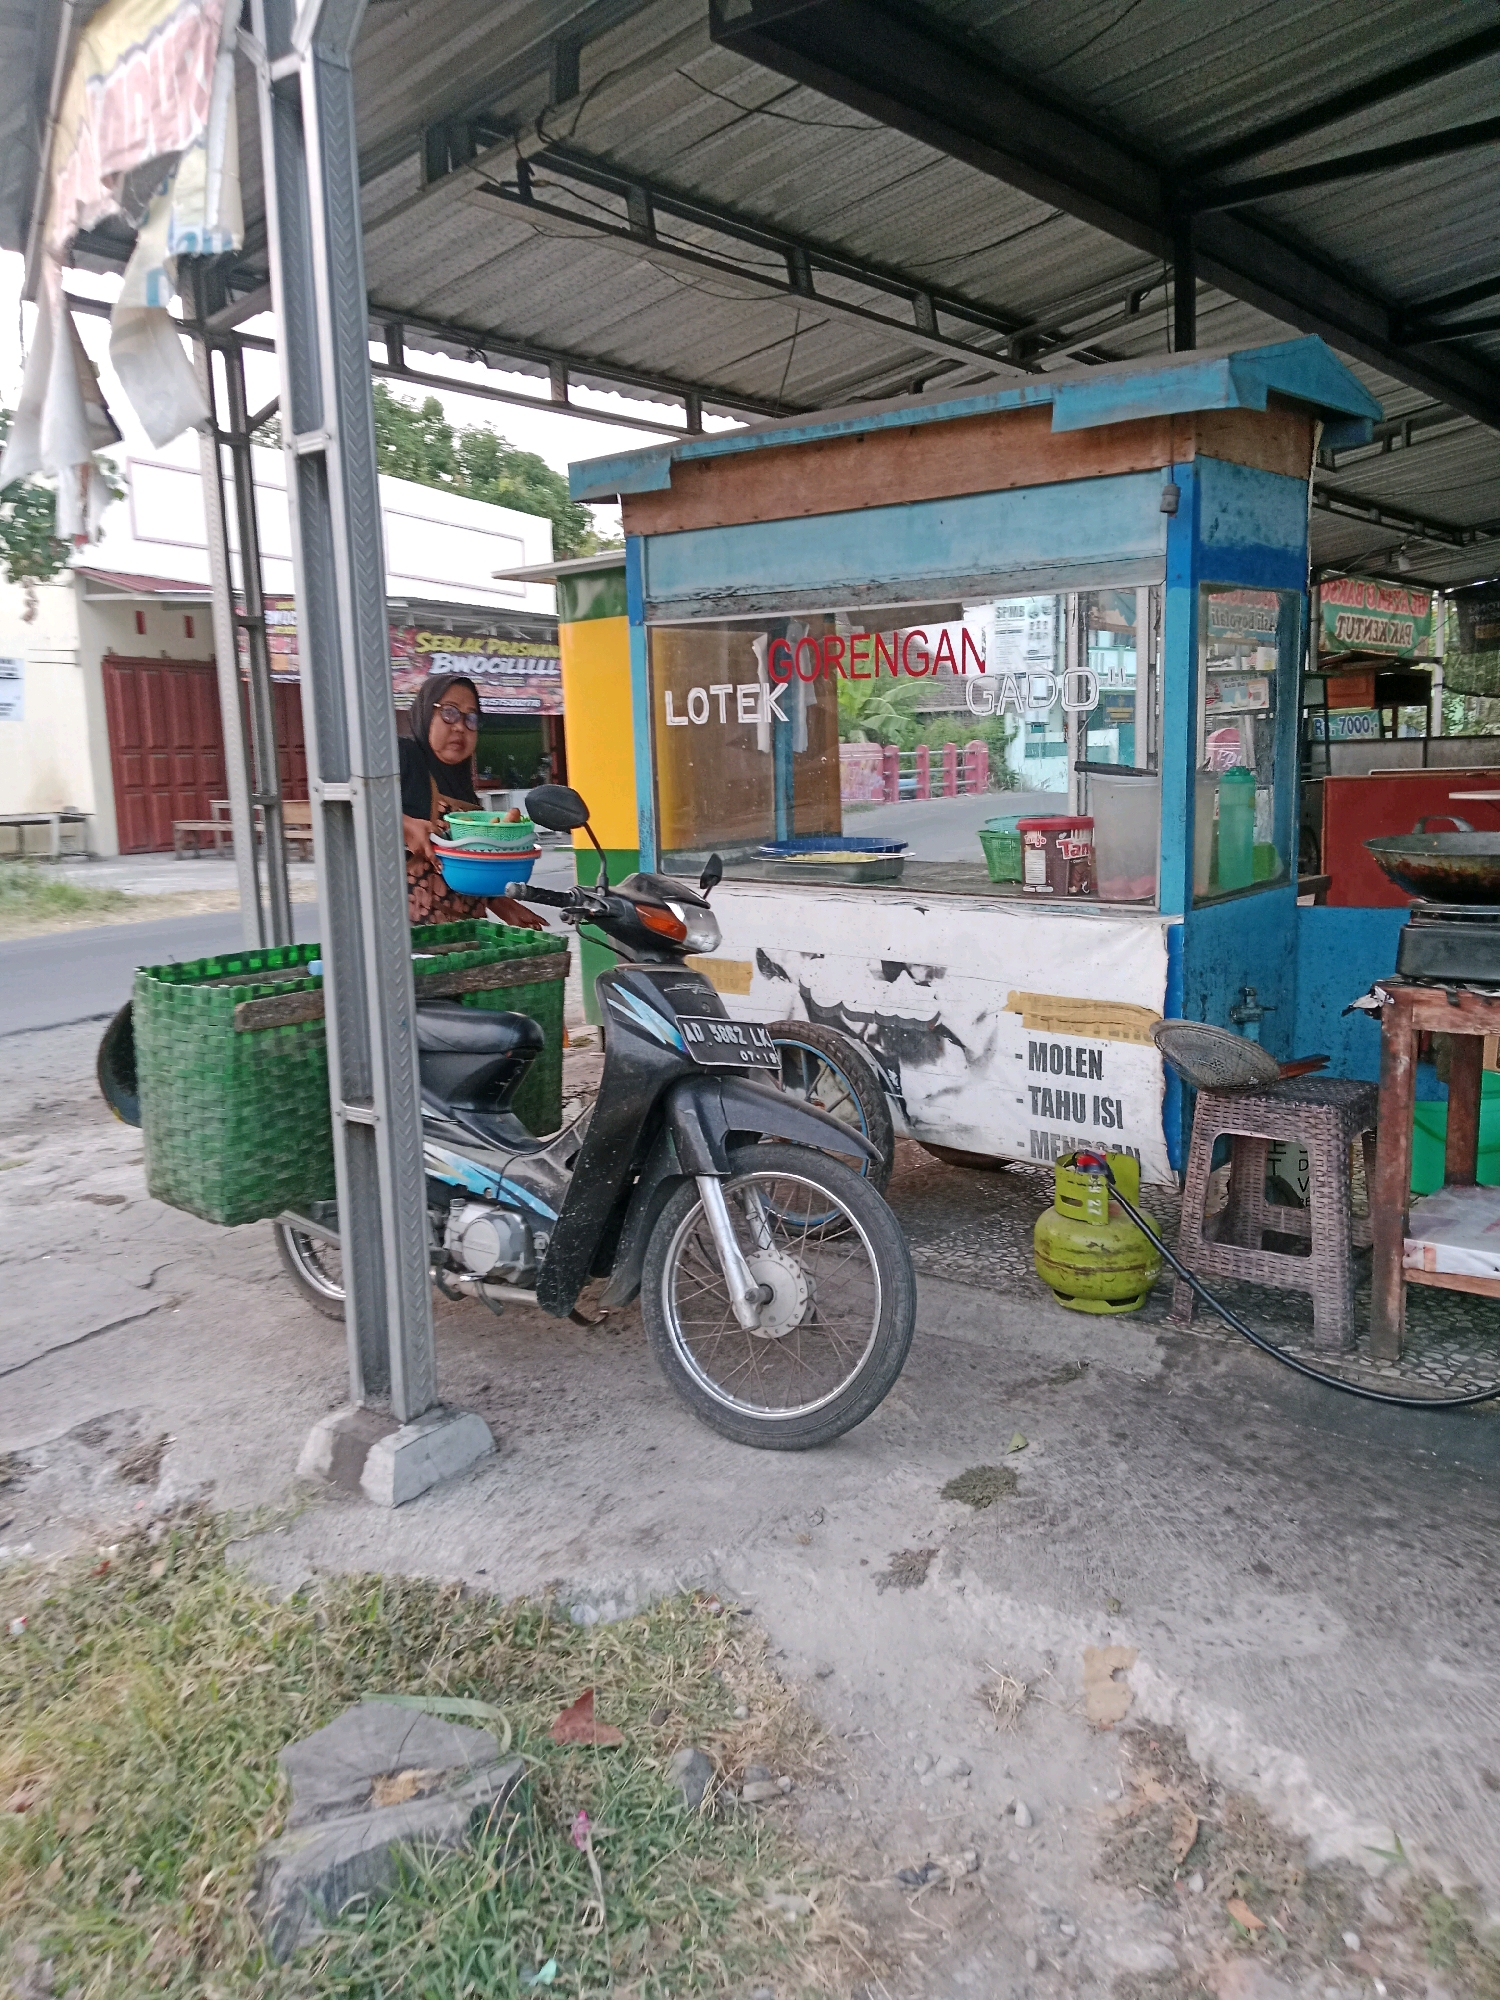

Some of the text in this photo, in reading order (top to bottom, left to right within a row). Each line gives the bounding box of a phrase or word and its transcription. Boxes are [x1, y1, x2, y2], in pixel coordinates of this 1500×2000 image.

[768, 627, 986, 684] GORENGAN
[664, 682, 790, 726] LOTEK
[683, 1022, 705, 1043] AD
[1028, 1041, 1103, 1081] MOLEN
[1028, 1085, 1124, 1129] TAHU ISI
